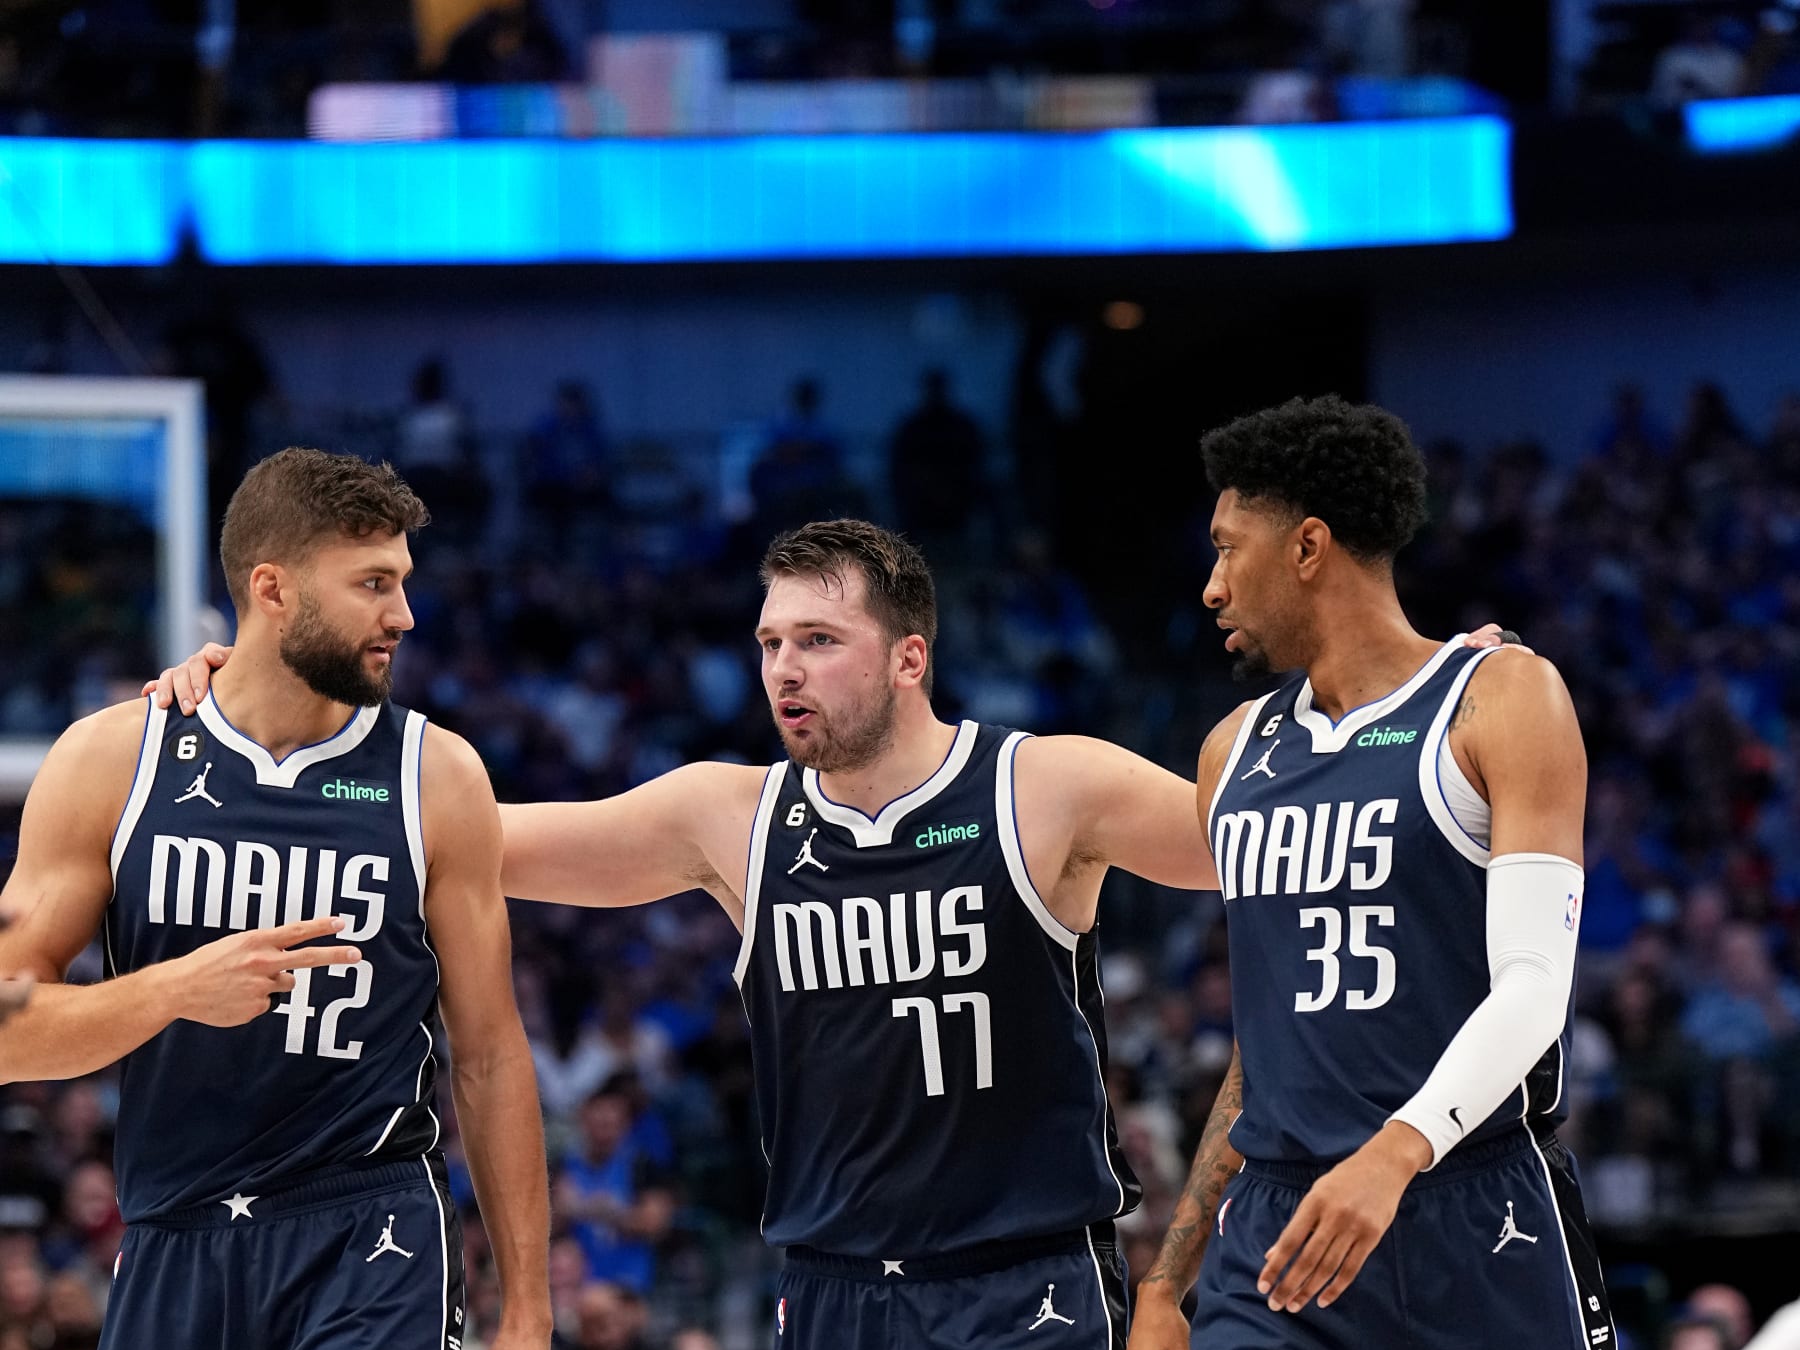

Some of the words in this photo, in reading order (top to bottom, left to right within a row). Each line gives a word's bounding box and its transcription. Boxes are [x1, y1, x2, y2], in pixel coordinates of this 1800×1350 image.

[1260, 713, 1284, 737] 6
[1356, 726, 1418, 747] chime
[176, 735, 198, 760] 6
[321, 778, 390, 802] chime
[785, 802, 806, 826] 6
[915, 822, 981, 849] chime
[1215, 798, 1400, 901] MAVS
[148, 834, 390, 942] MAVS
[772, 885, 988, 993] MAVS
[1294, 905, 1396, 1013] 35
[891, 991, 993, 1097] 77
